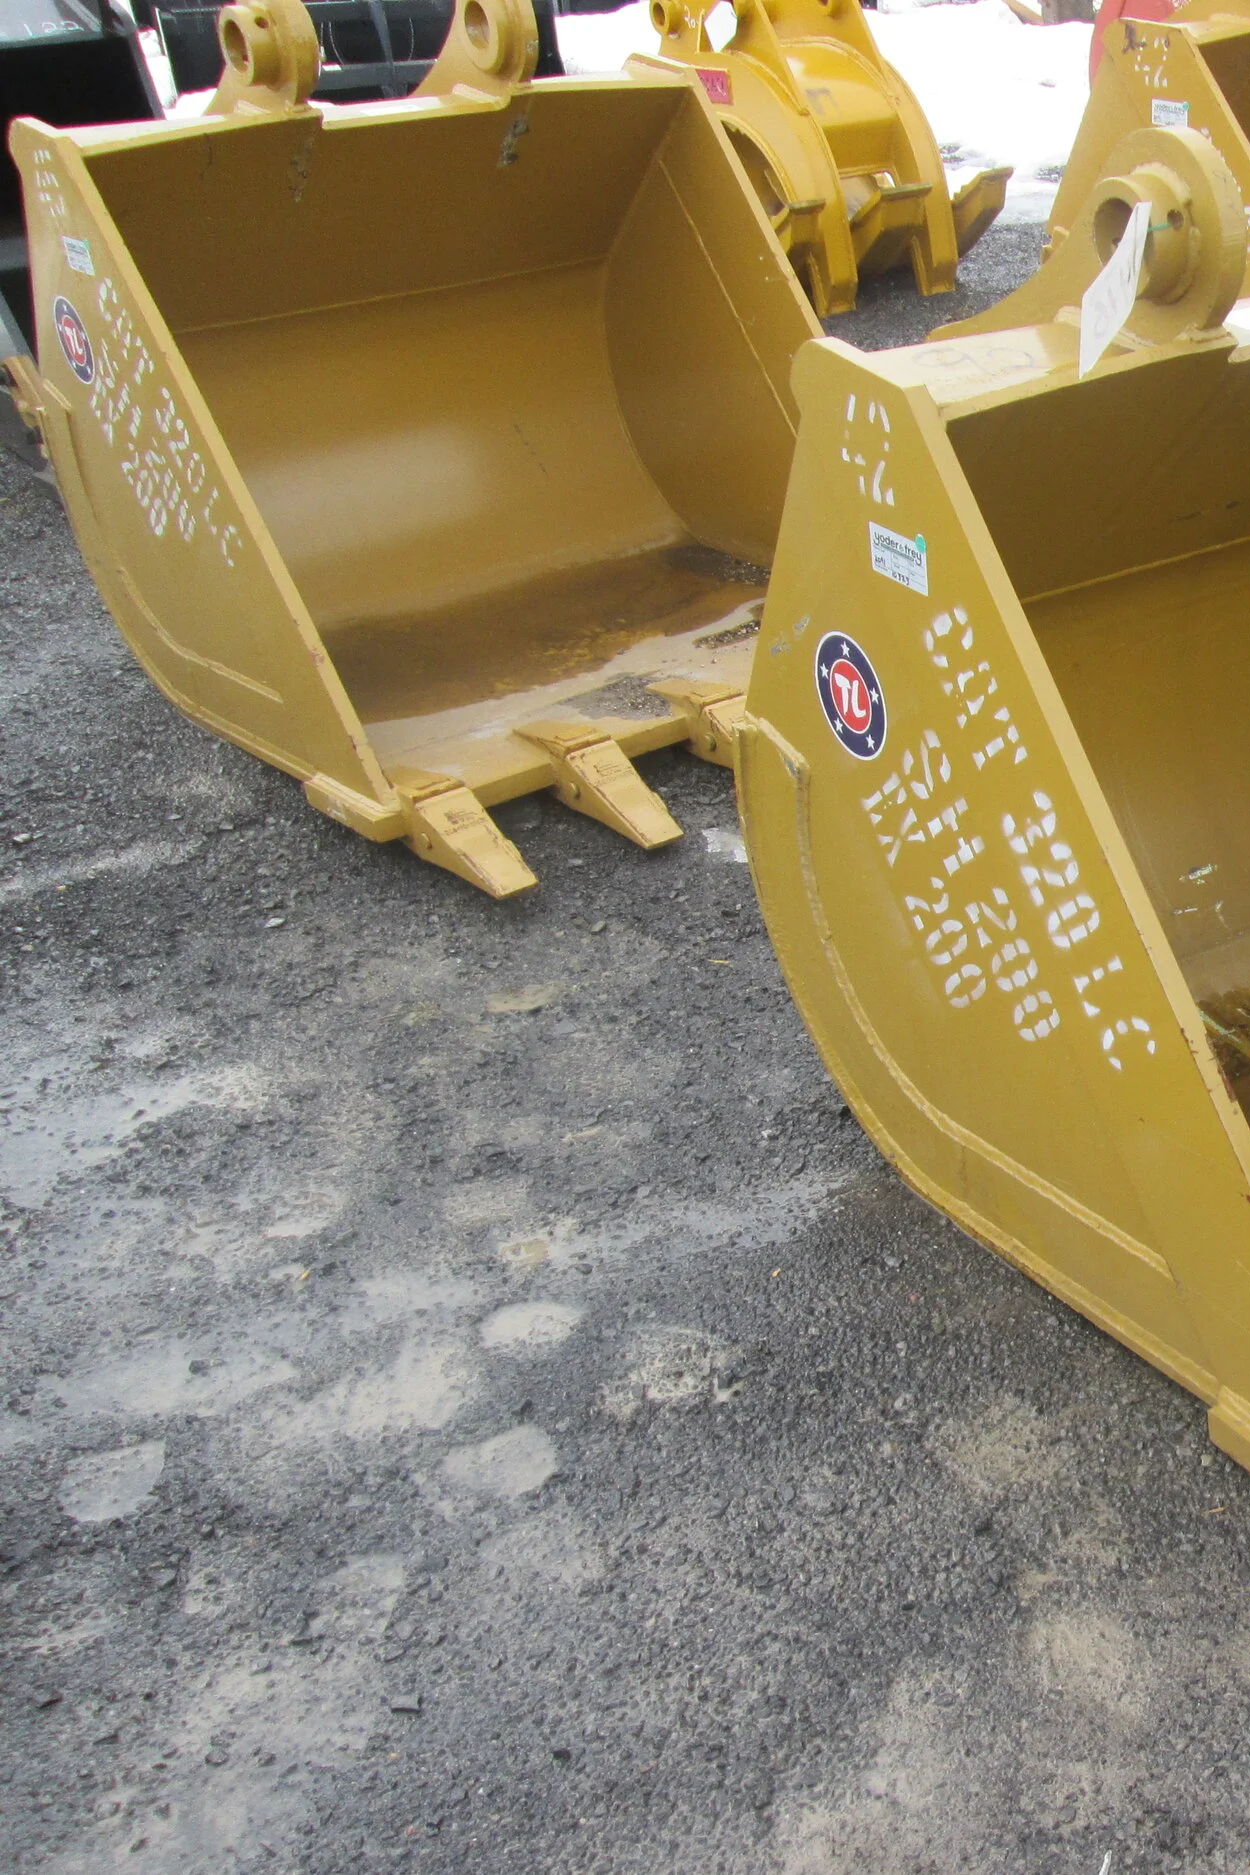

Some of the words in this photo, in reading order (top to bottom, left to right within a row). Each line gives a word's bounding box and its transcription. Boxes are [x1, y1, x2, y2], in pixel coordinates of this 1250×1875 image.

[860, 770, 927, 867] EX
[904, 875, 986, 1009] 200
[902, 729, 985, 876] SH
[964, 885, 1061, 1043] 200
[925, 606, 1028, 770] CAT
[1001, 791, 1099, 949] 320
